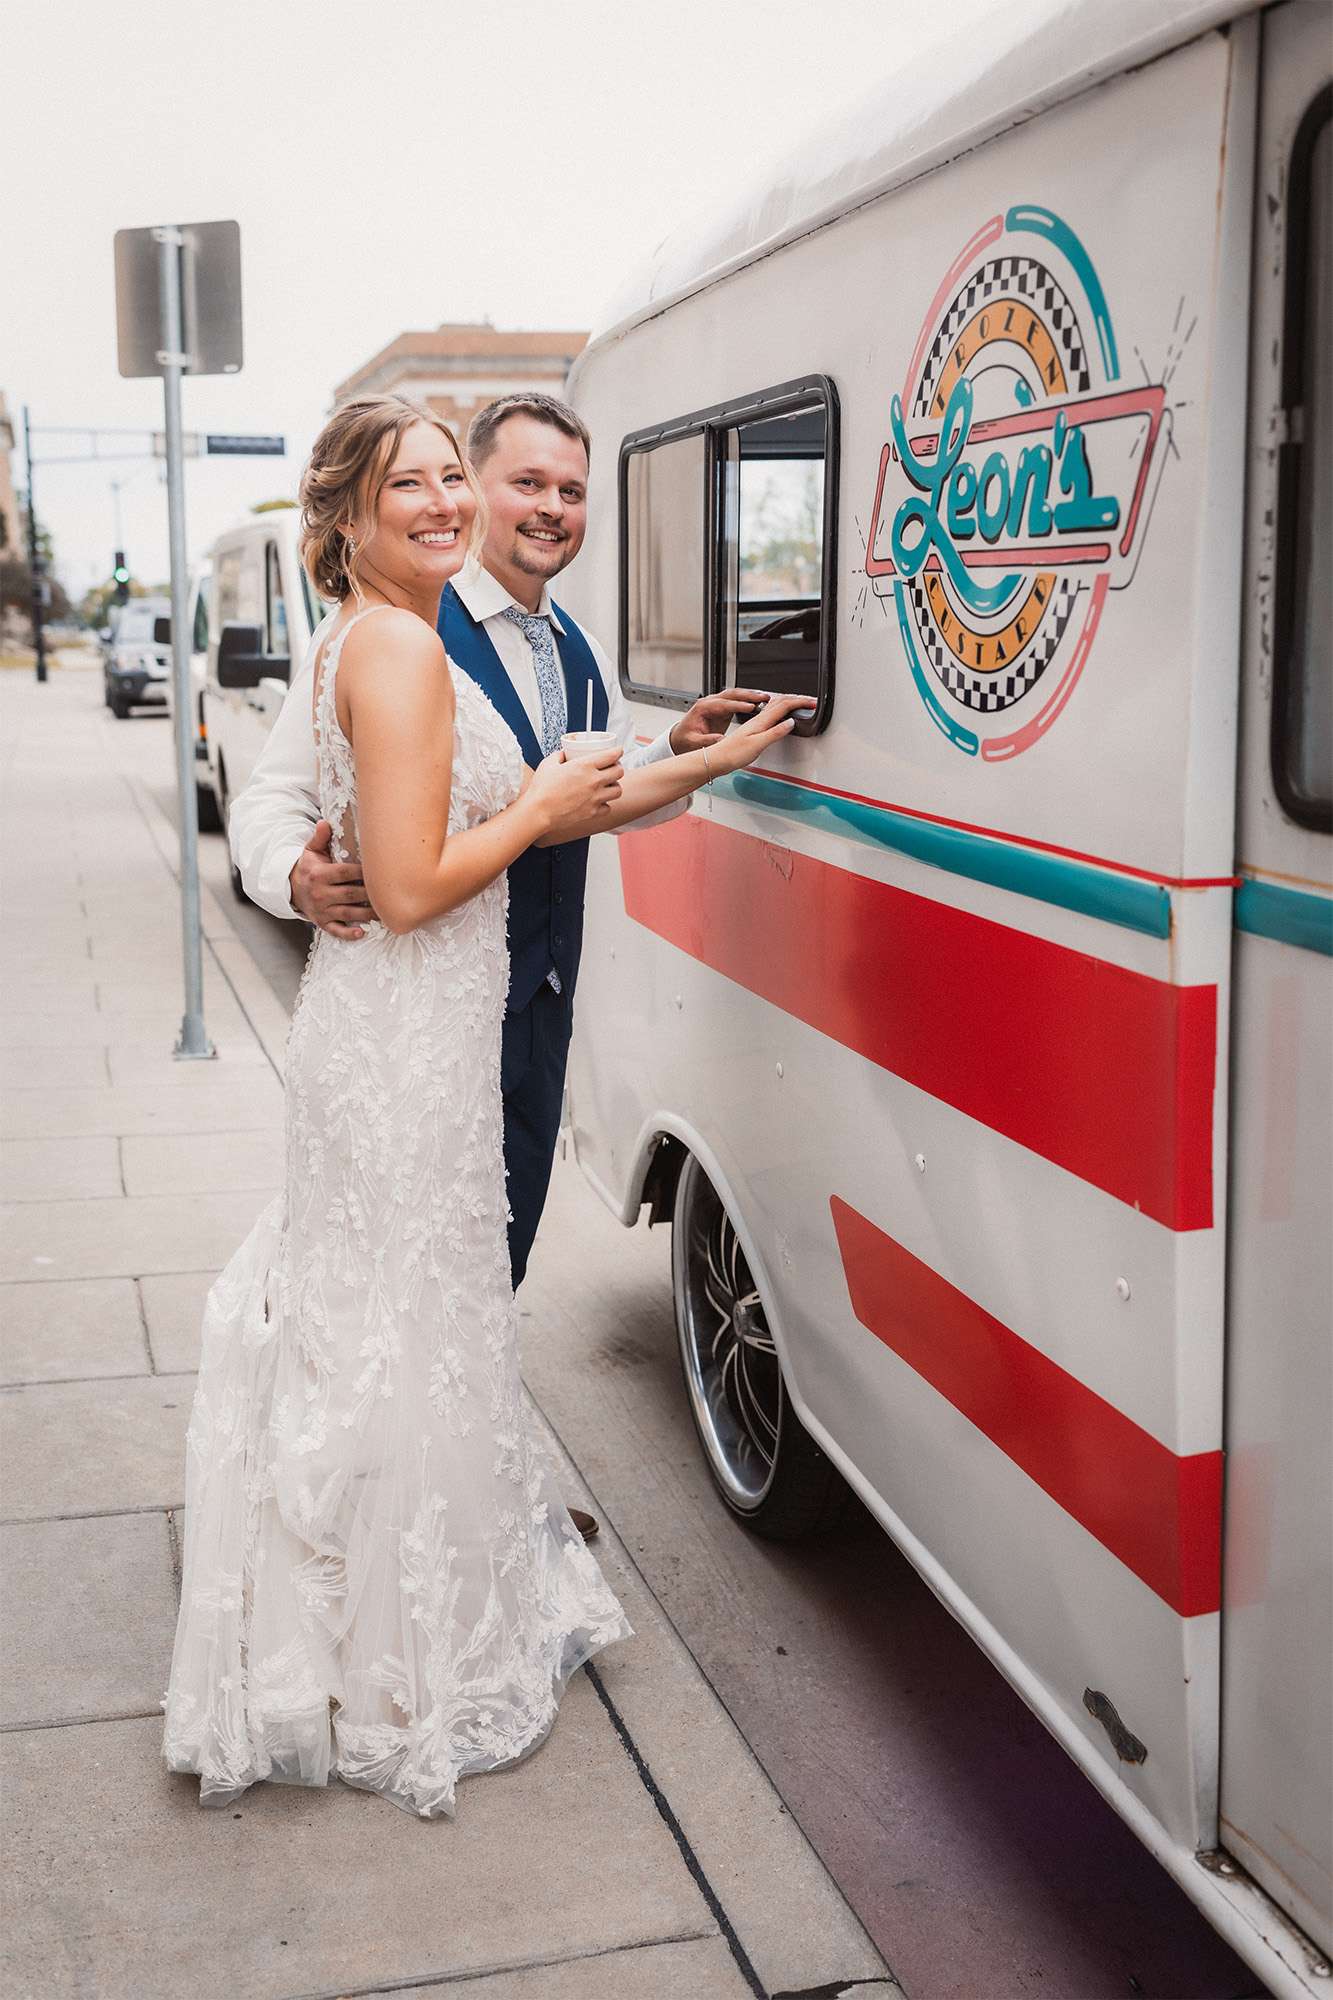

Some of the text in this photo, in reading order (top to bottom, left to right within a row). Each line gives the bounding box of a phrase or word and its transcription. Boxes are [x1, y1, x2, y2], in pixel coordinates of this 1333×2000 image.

[937, 307, 1060, 411] FROZEN
[890, 377, 1120, 612] Leon's
[929, 577, 1047, 665] CUSTARD
